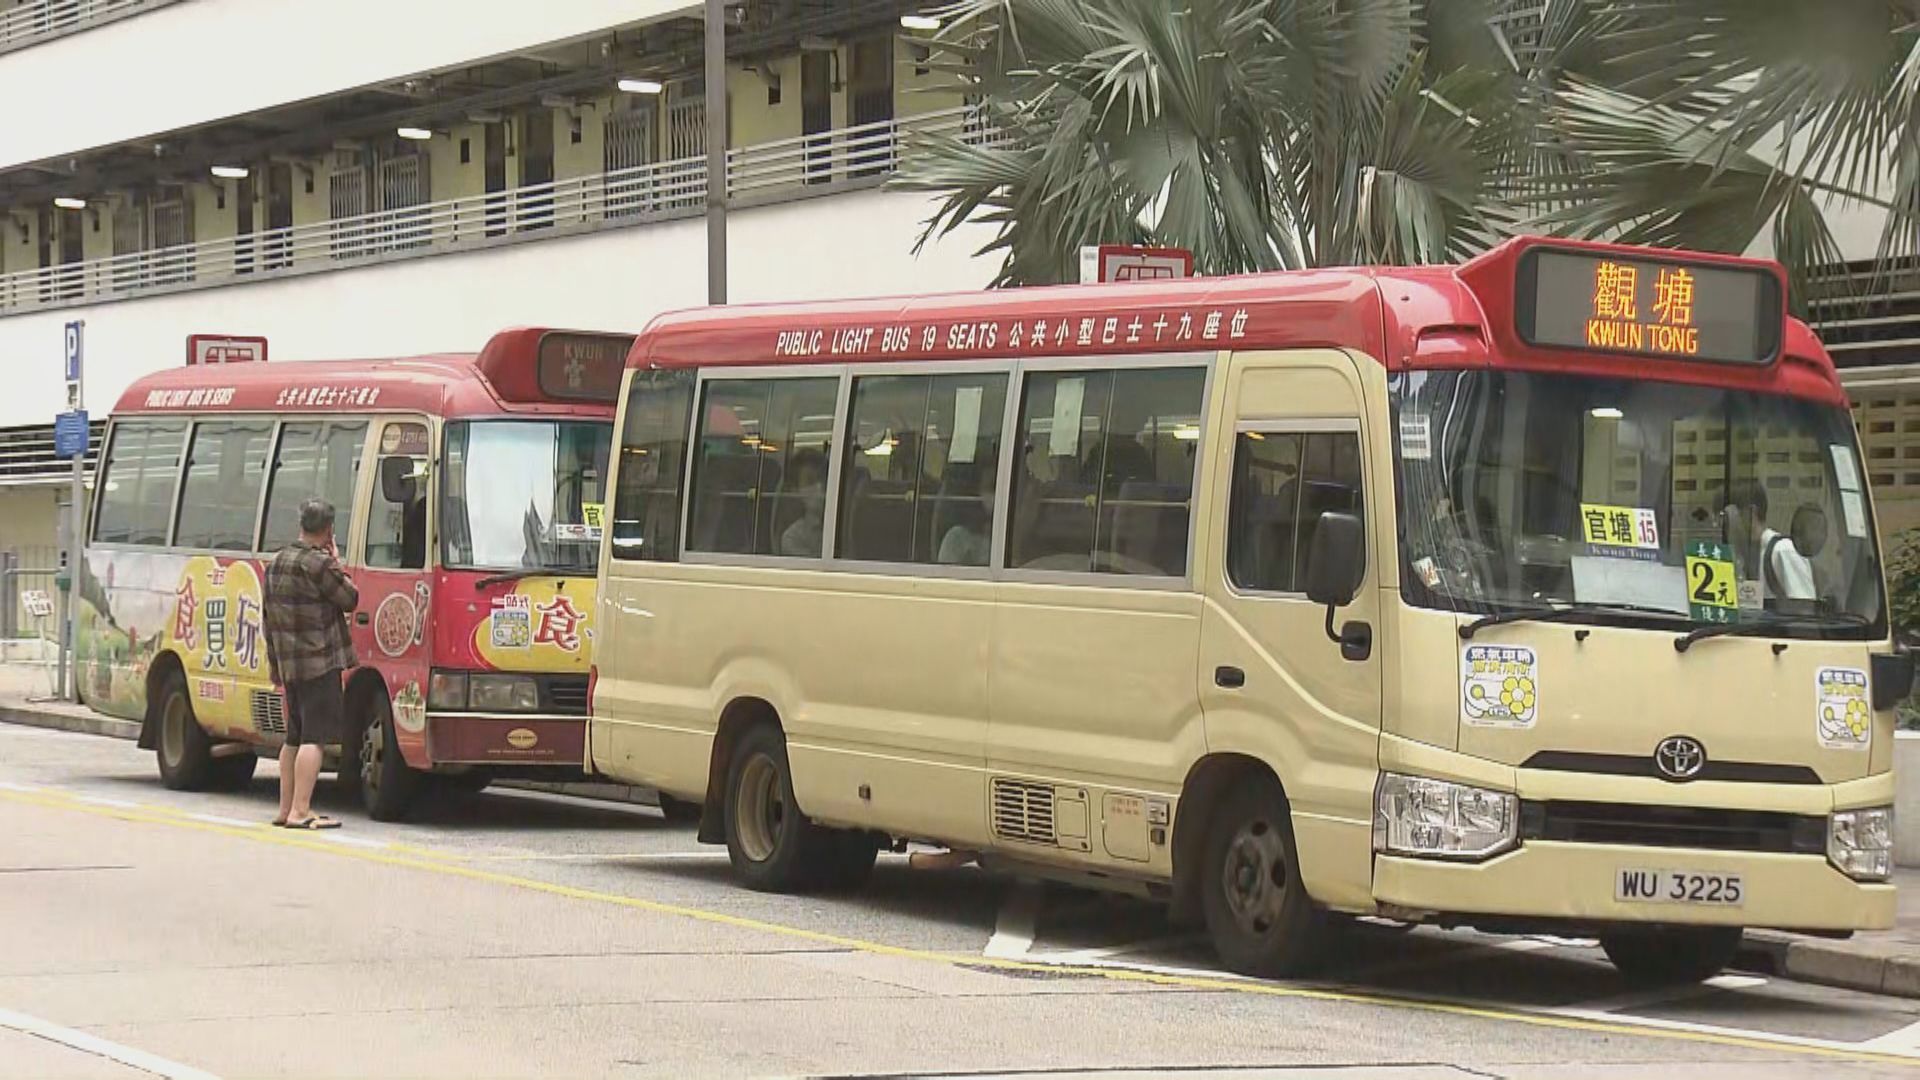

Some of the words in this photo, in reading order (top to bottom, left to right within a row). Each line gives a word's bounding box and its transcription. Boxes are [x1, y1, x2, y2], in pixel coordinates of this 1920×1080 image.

[1594, 262, 1694, 325] 觀塘
[775, 330, 823, 356] PUBLIC
[831, 328, 874, 354] LIGHT
[881, 326, 911, 352] BUS
[921, 325, 937, 351] 19
[947, 322, 998, 350] SEATS
[1009, 308, 1249, 348] 公共小型巴士十九座位
[1587, 319, 1642, 350] KWUN
[1647, 325, 1699, 354] TONG
[66, 326, 78, 377] P
[1584, 508, 1633, 543] 官塘
[1622, 871, 1657, 897] WU
[1669, 873, 1741, 903] 3225
